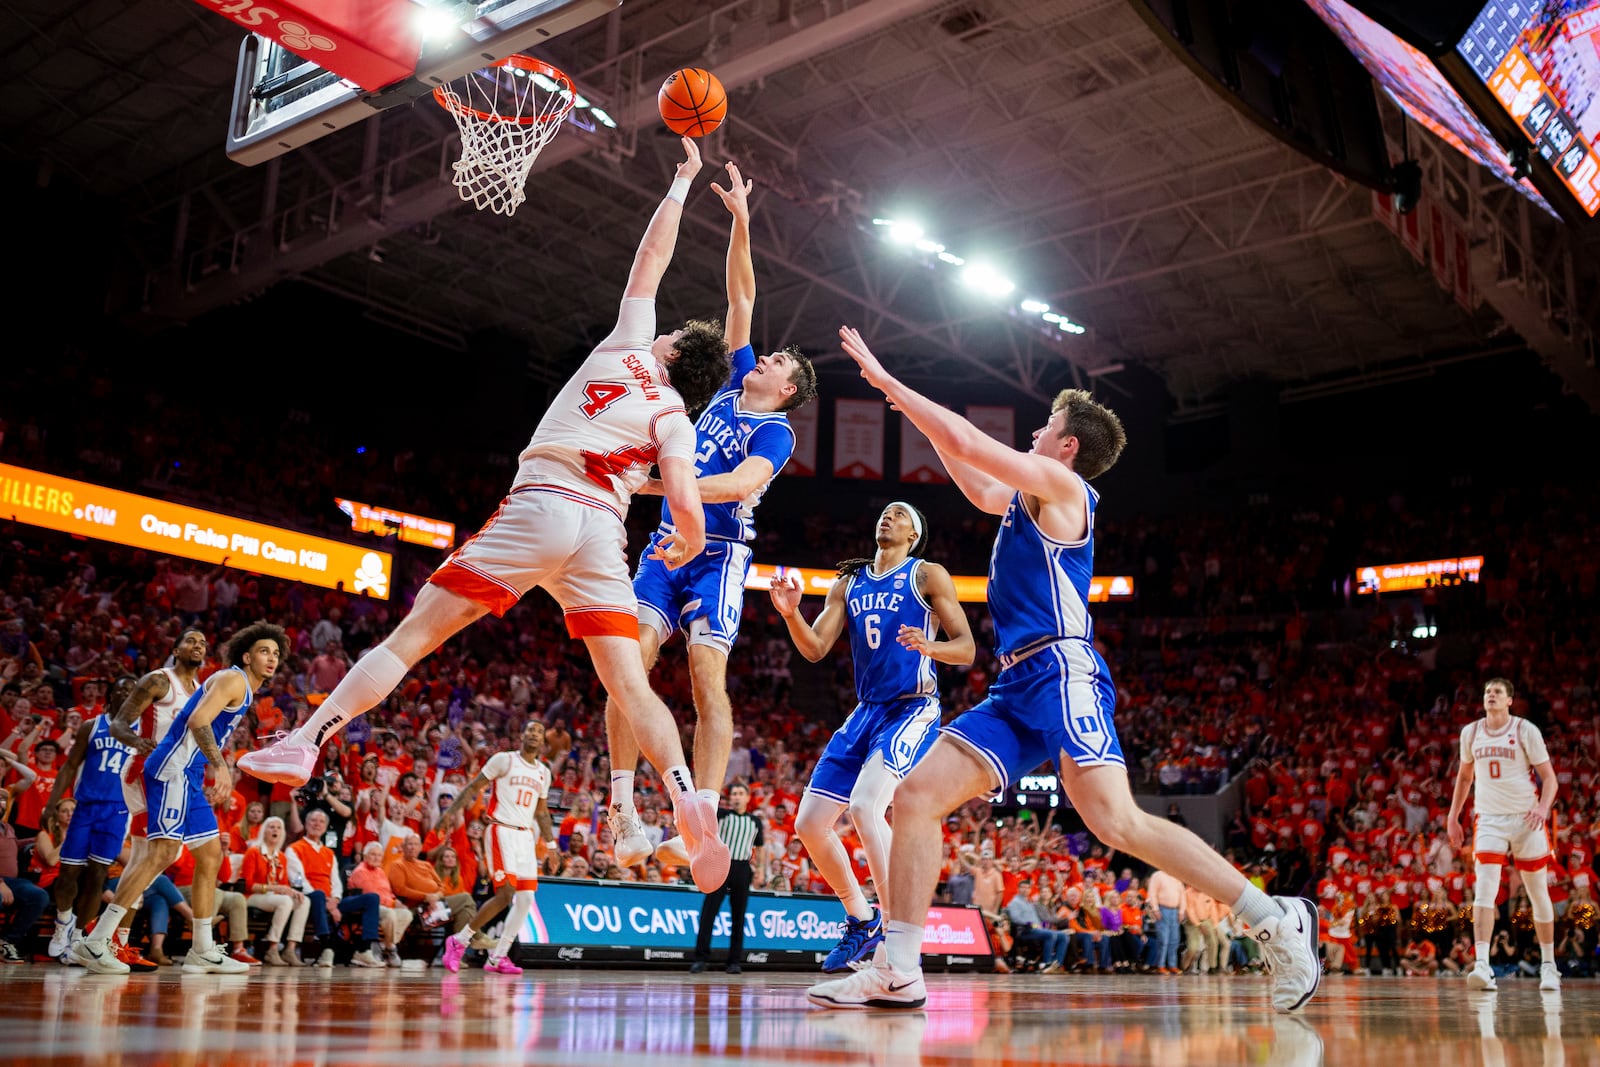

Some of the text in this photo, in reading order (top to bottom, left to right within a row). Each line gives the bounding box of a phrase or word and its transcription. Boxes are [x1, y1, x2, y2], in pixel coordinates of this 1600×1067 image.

[1529, 102, 1552, 132] 44
[1563, 145, 1584, 173] 46
[579, 380, 632, 420] 4
[699, 412, 741, 460] DUKE
[693, 439, 717, 477] 2
[0, 476, 328, 571] ILLERS.COM One Fake Pill Can Kill
[727, 604, 738, 624] D
[849, 592, 905, 618] DUKE
[864, 613, 881, 650] 6
[1075, 715, 1099, 734] D
[98, 750, 123, 774] 14
[899, 740, 912, 759] D
[1475, 746, 1516, 760] CLEMSON
[1489, 760, 1501, 779] 0
[515, 788, 533, 808] 10
[165, 807, 179, 820] D
[564, 903, 622, 933] YOU
[629, 906, 700, 935] CAN'T
[712, 911, 757, 937] BET
[760, 909, 798, 939] The
